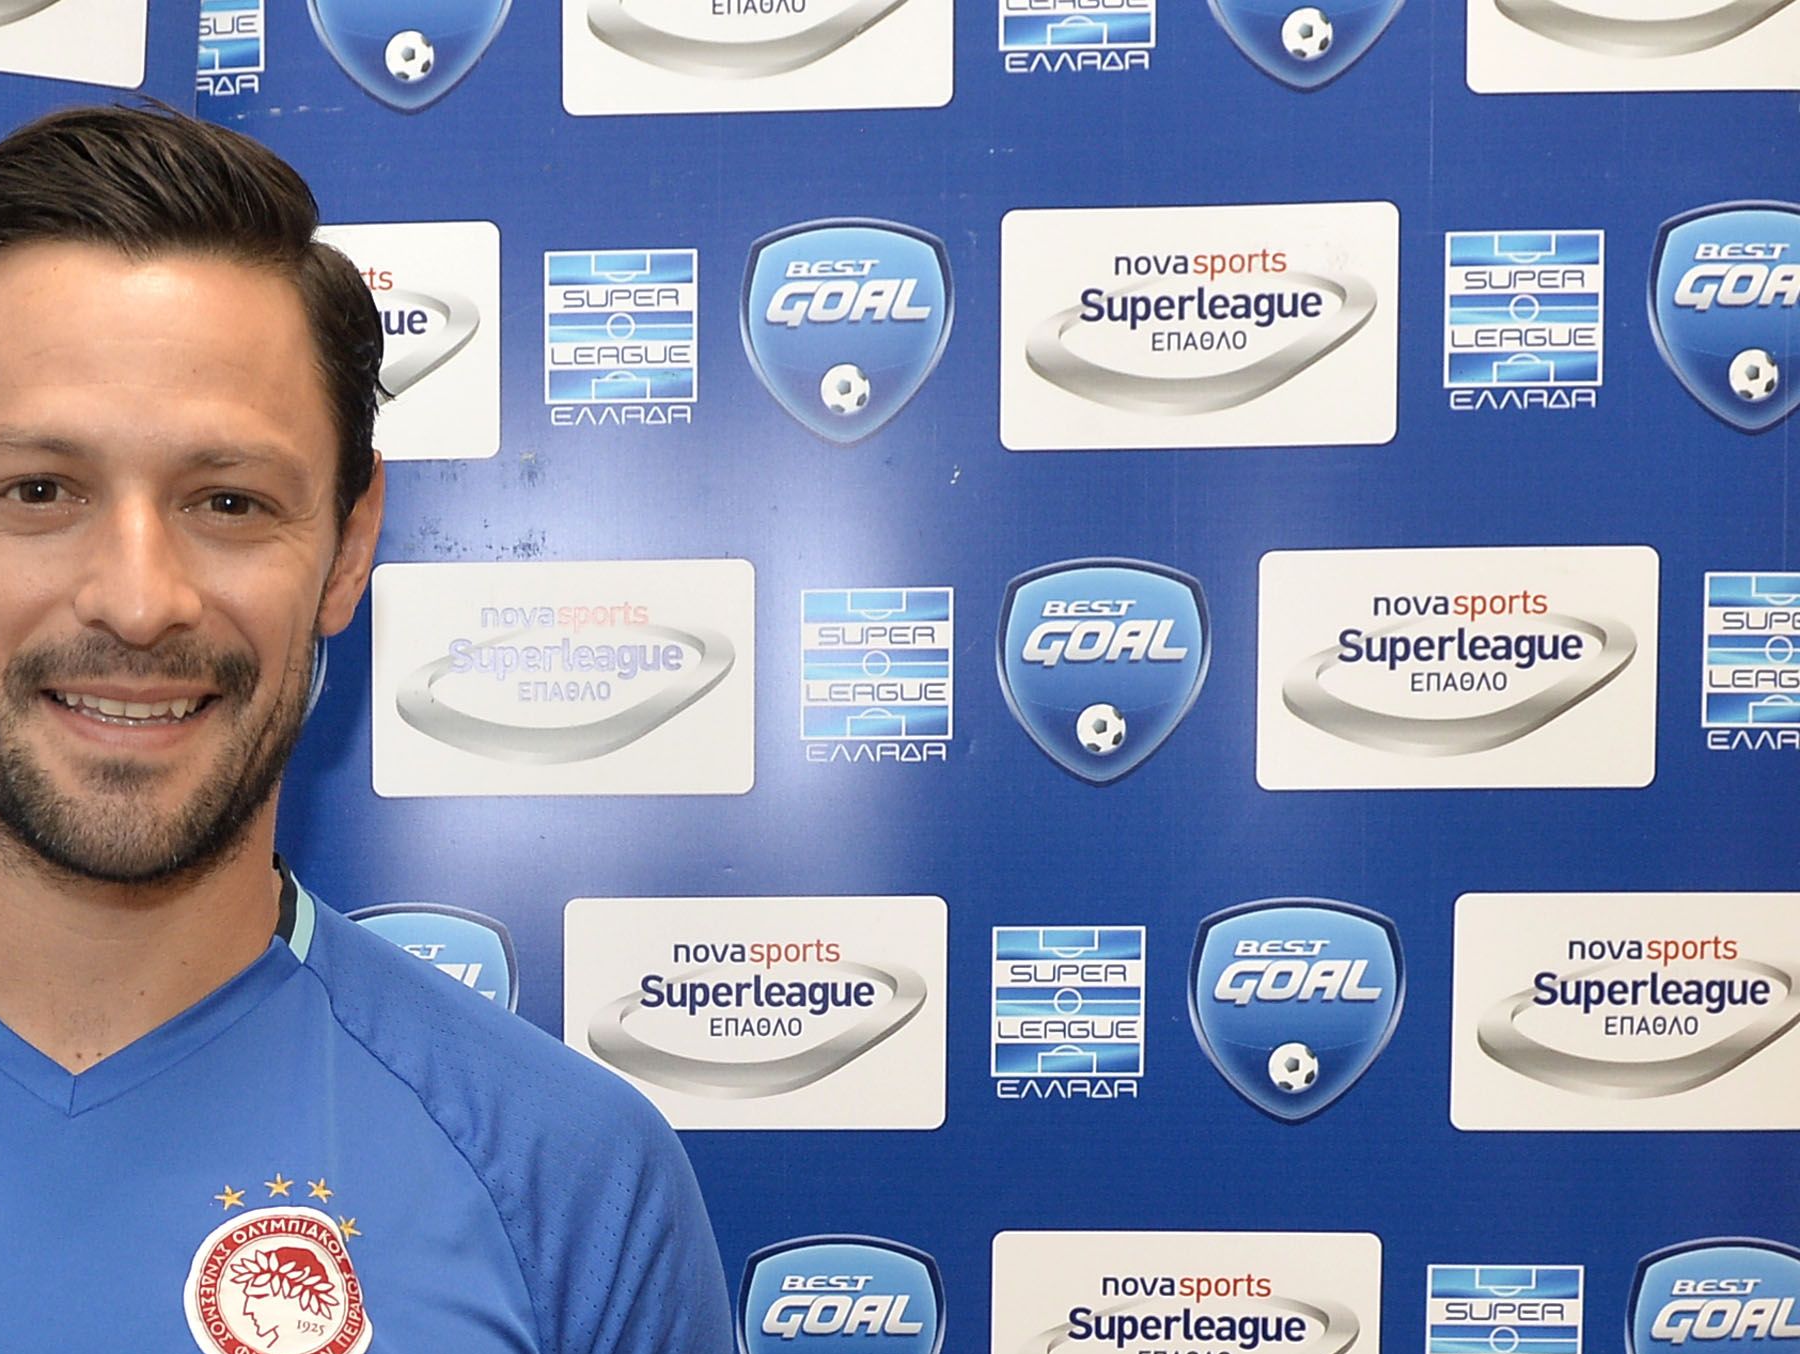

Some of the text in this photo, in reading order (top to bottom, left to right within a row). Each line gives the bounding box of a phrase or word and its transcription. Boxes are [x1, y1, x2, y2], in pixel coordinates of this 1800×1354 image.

[786, 259, 880, 277] BEST
[1115, 250, 1286, 280] novasports
[1465, 270, 1584, 289] SUPER
[563, 289, 679, 308] SUPER
[766, 279, 931, 326] GOAL
[1080, 287, 1322, 330] Superleague
[1152, 331, 1246, 351] ΕΠΑΘΛΟ
[1452, 328, 1595, 347] LEAGUE
[552, 345, 690, 365] LEAGUE
[1043, 599, 1137, 616] BEST
[1374, 591, 1547, 621] novasports
[819, 626, 935, 644] SUPER
[1022, 619, 1188, 665] GOAL
[1339, 628, 1582, 670] Superleague
[448, 638, 684, 681] Superleague
[807, 683, 944, 701] LEAGUE
[1411, 672, 1507, 691] ΕΠΑΘΛΟ
[674, 940, 840, 969] novasports
[1569, 937, 1737, 966] novasports
[1011, 965, 1126, 982] SUPER
[1214, 958, 1382, 1004] GOAL
[641, 975, 874, 1015] Superleague
[1533, 972, 1770, 1013] Superleague
[711, 1018, 801, 1036] ΕΠΑΘΛΟ
[998, 1021, 1137, 1038] LEAGUE
[1605, 1016, 1698, 1035] ΕΠΑΘΛΟ
[233, 1218, 347, 1263] ΟΛΥΜΠΙΑΚΟΣ
[200, 1244, 234, 1347] ΣΥΝΔΕΣΜΟΣ
[1103, 1274, 1271, 1303] novasports
[762, 1293, 923, 1337] GOAL
[1446, 1303, 1564, 1321] SUPER
[297, 1320, 325, 1336] 1925
[1068, 1308, 1305, 1349] Superleague
